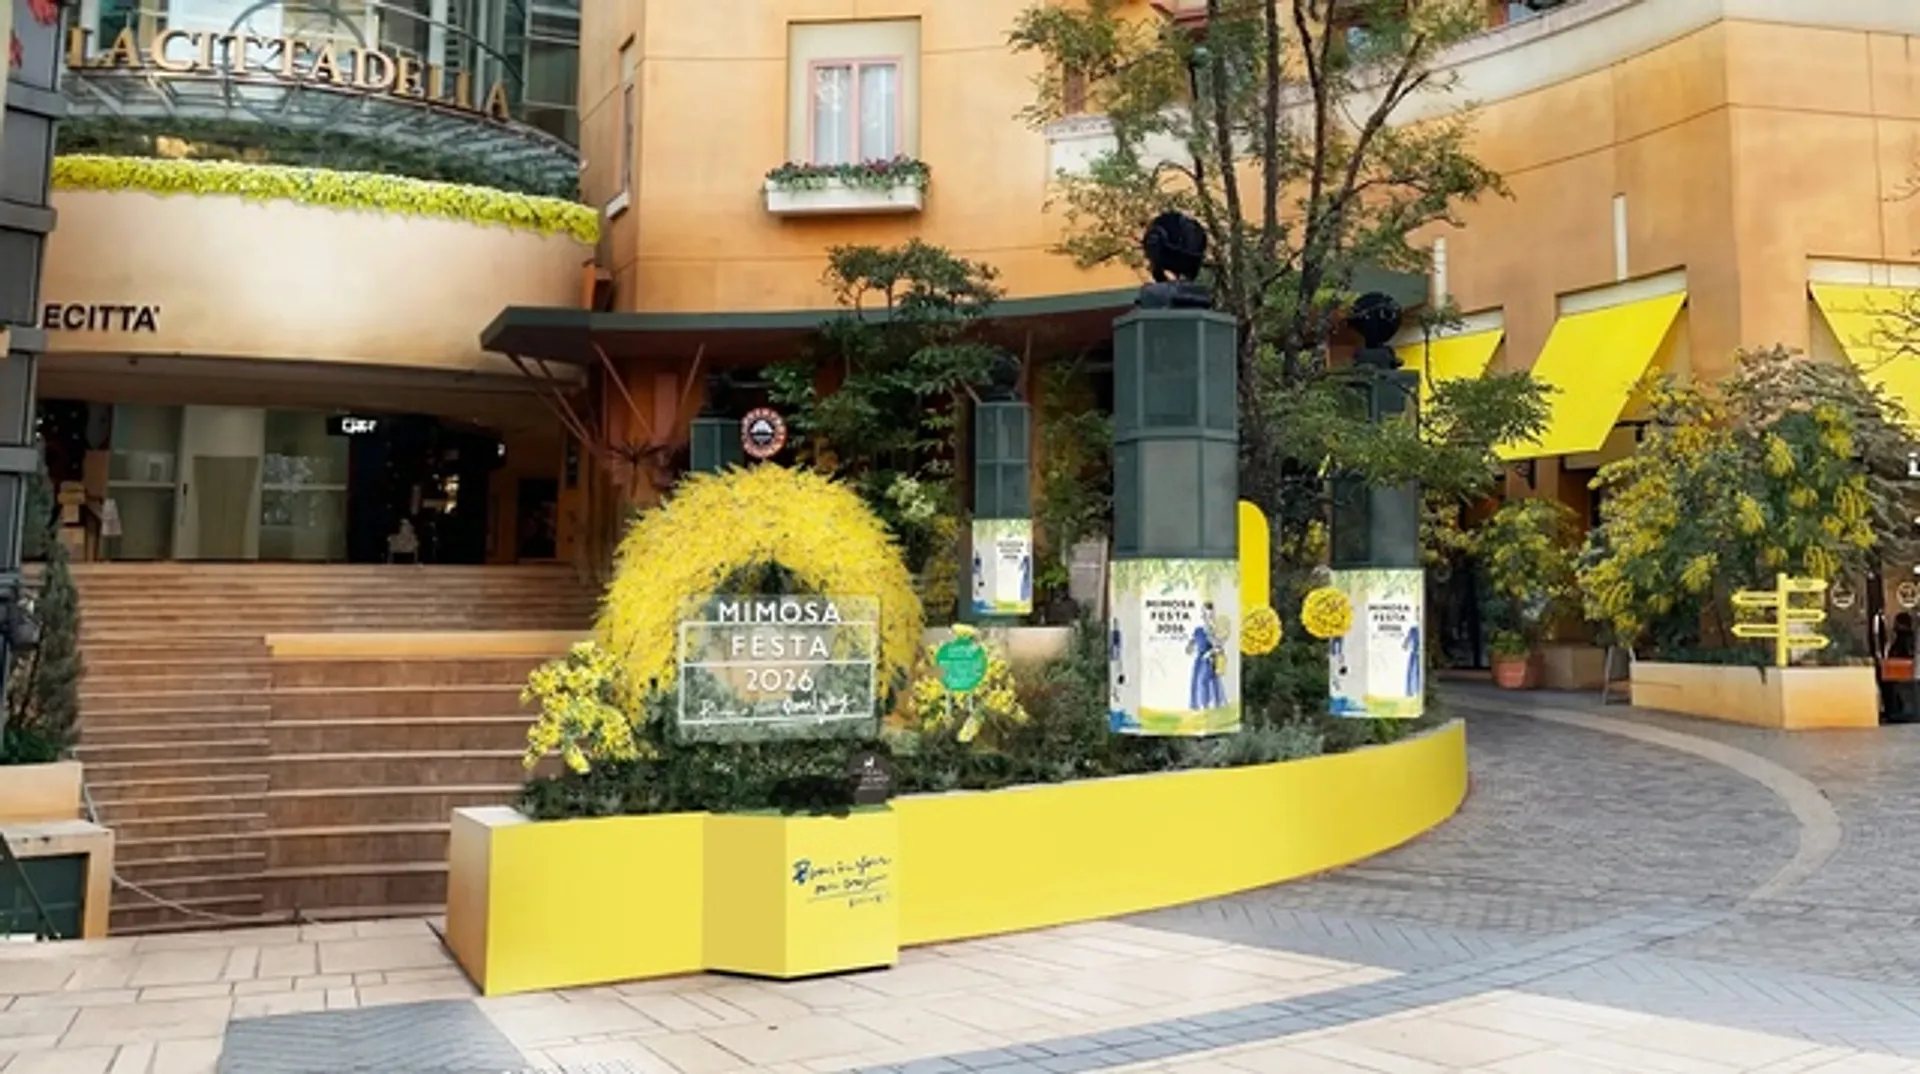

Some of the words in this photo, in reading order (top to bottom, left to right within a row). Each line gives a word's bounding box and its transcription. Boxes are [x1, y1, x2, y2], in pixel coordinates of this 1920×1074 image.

[719, 601, 841, 623] MIMOSA
[1150, 611, 1191, 621] FESTA
[731, 635, 829, 658] FESTA
[746, 668, 814, 692] 2026
